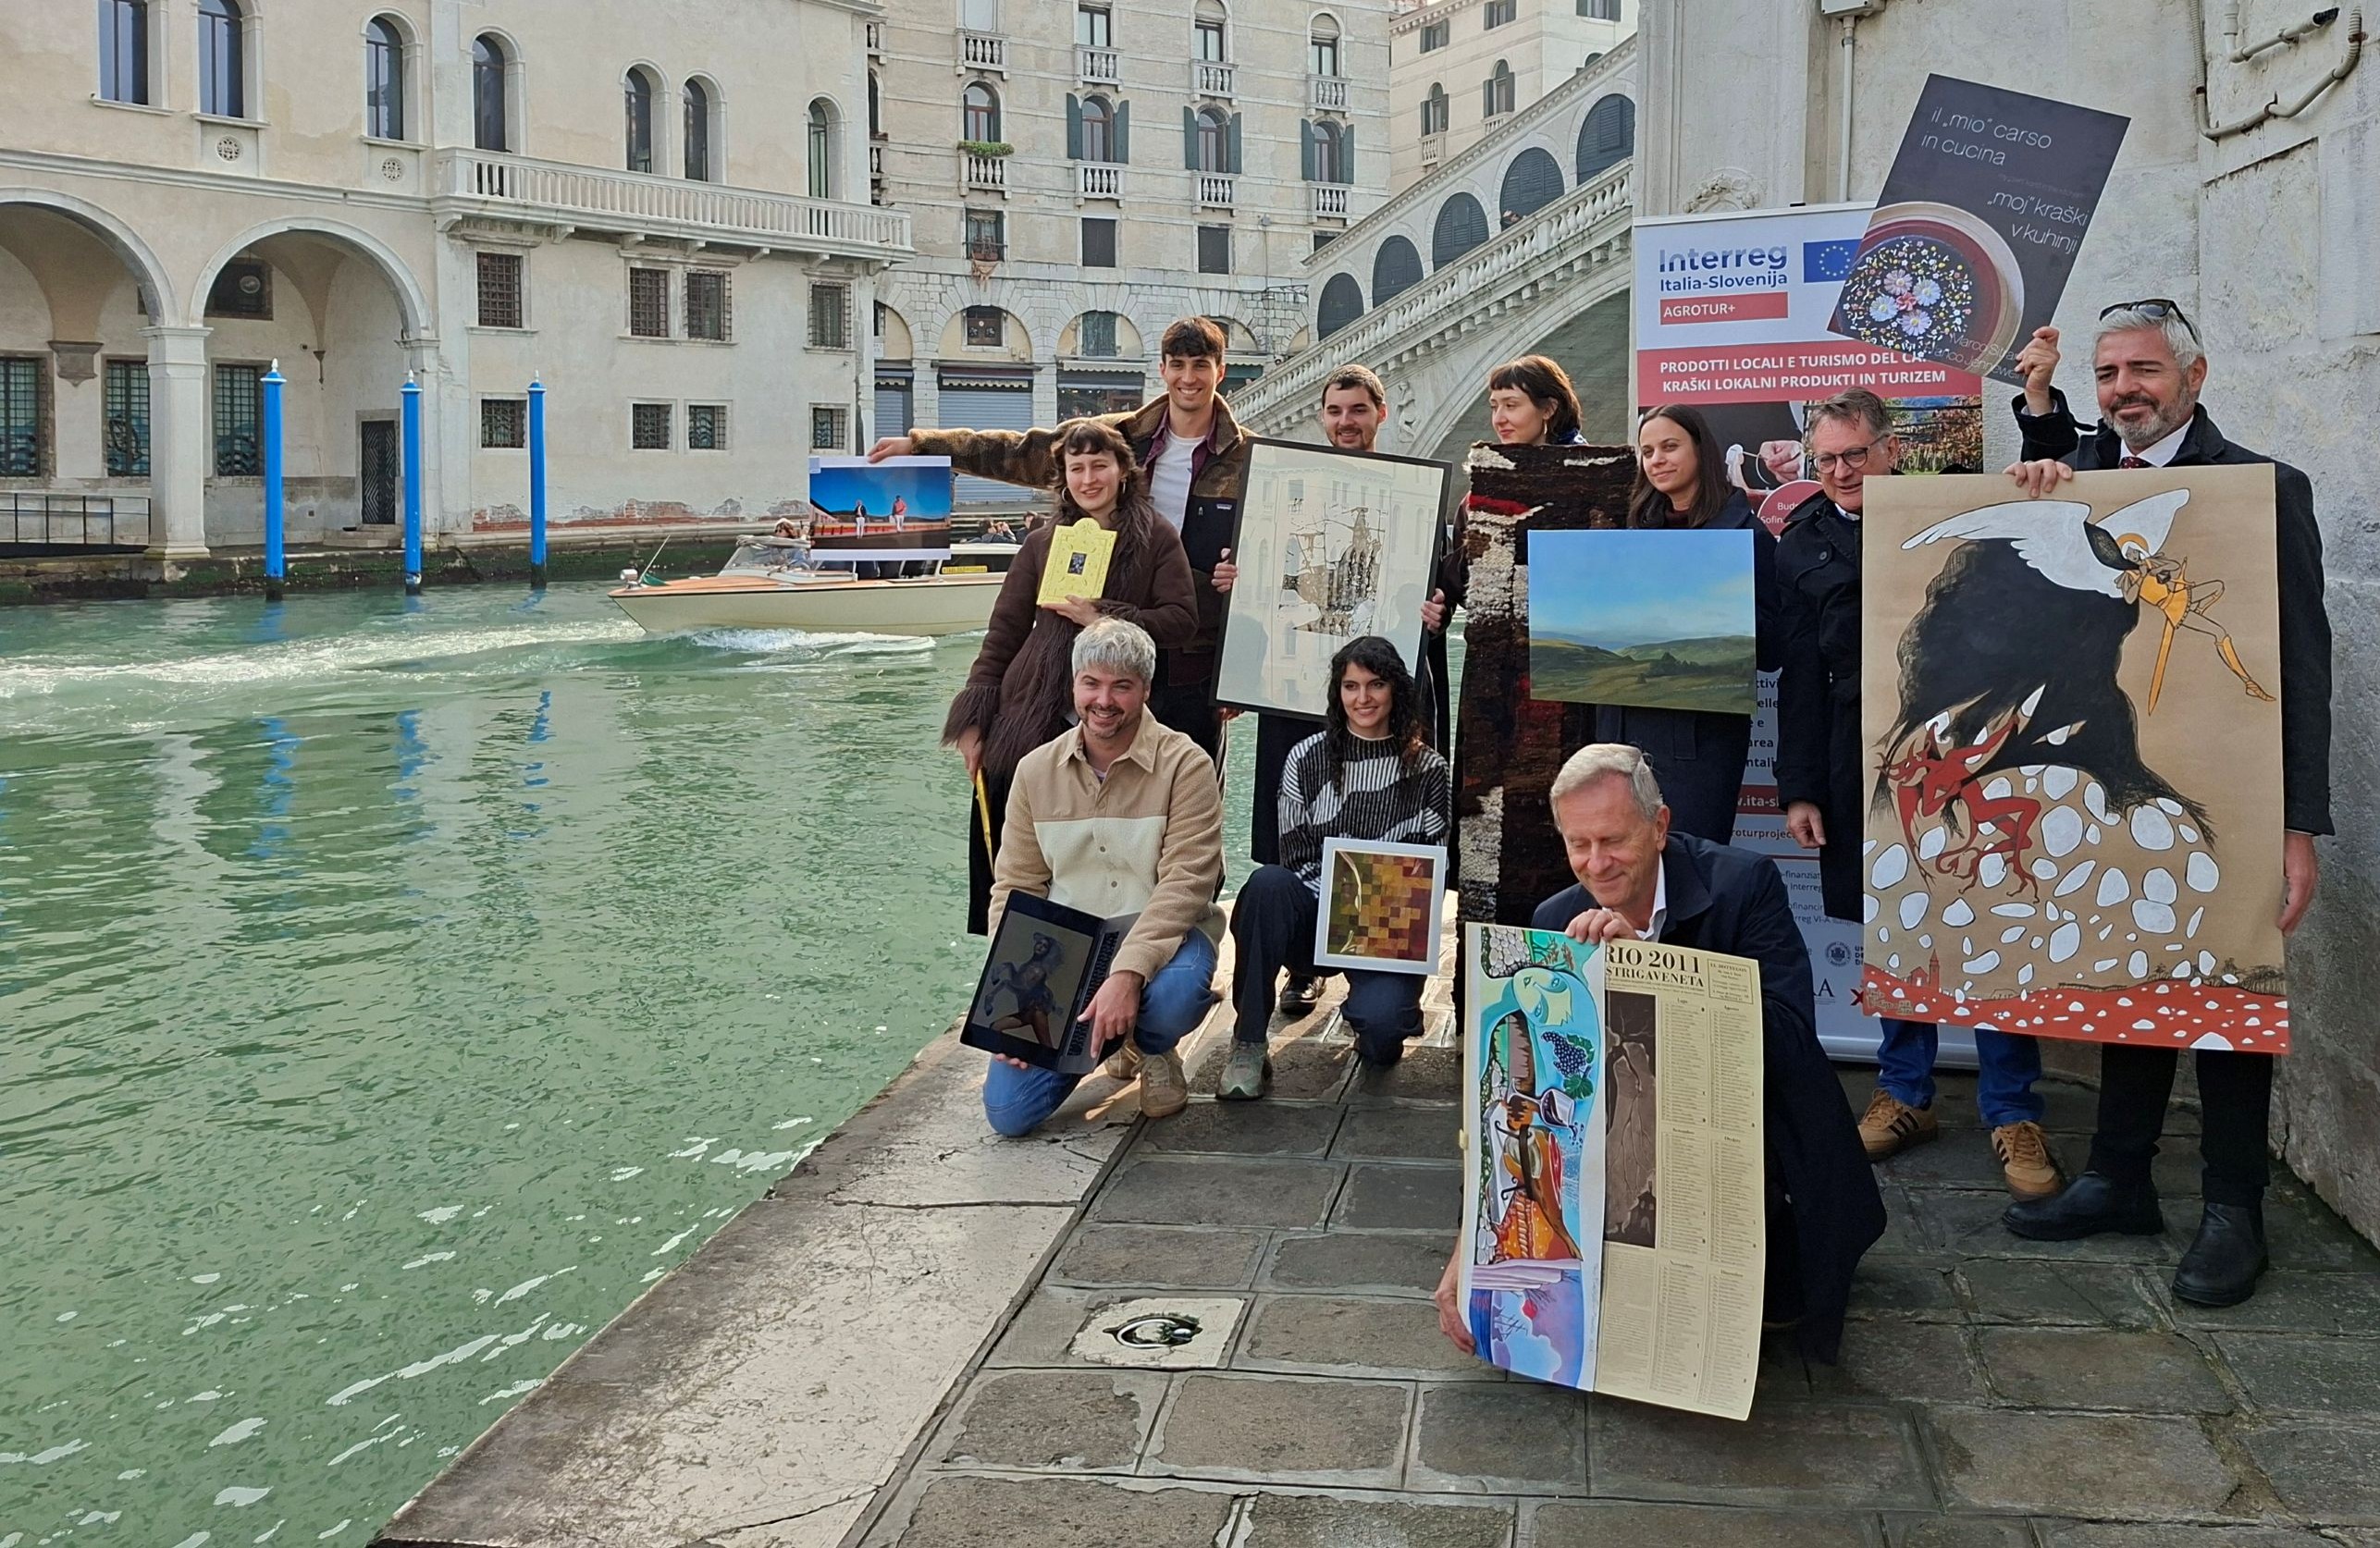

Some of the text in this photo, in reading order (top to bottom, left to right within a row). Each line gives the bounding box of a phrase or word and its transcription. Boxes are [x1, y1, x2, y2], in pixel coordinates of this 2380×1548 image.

[1930, 106, 1942, 123] il
[1993, 124, 2052, 149] carso
[1921, 130, 2006, 166] in cucina
[2034, 198, 2090, 227] kraški
[2012, 223, 2080, 254] v kuhinji
[1659, 246, 1788, 273] Interreg
[1660, 271, 1788, 291] Italia-Slovenija
[1663, 303, 1736, 318] AGROTUR+
[1660, 359, 1729, 374] PRODOTTI
[1733, 356, 1783, 370] LOCALI
[1788, 356, 1795, 368] E
[1799, 353, 1867, 367] TURISMO
[1871, 352, 1898, 364] DEL
[1663, 370, 1946, 392] KRAŠKI LOKALNI PRODUKTI IN TURIZEM
[1777, 501, 1798, 510] Bud
[1760, 515, 1783, 524] Sofin
[1757, 698, 1779, 708] elle
[1605, 945, 1643, 965] RIO
[1648, 950, 1701, 974] 2011
